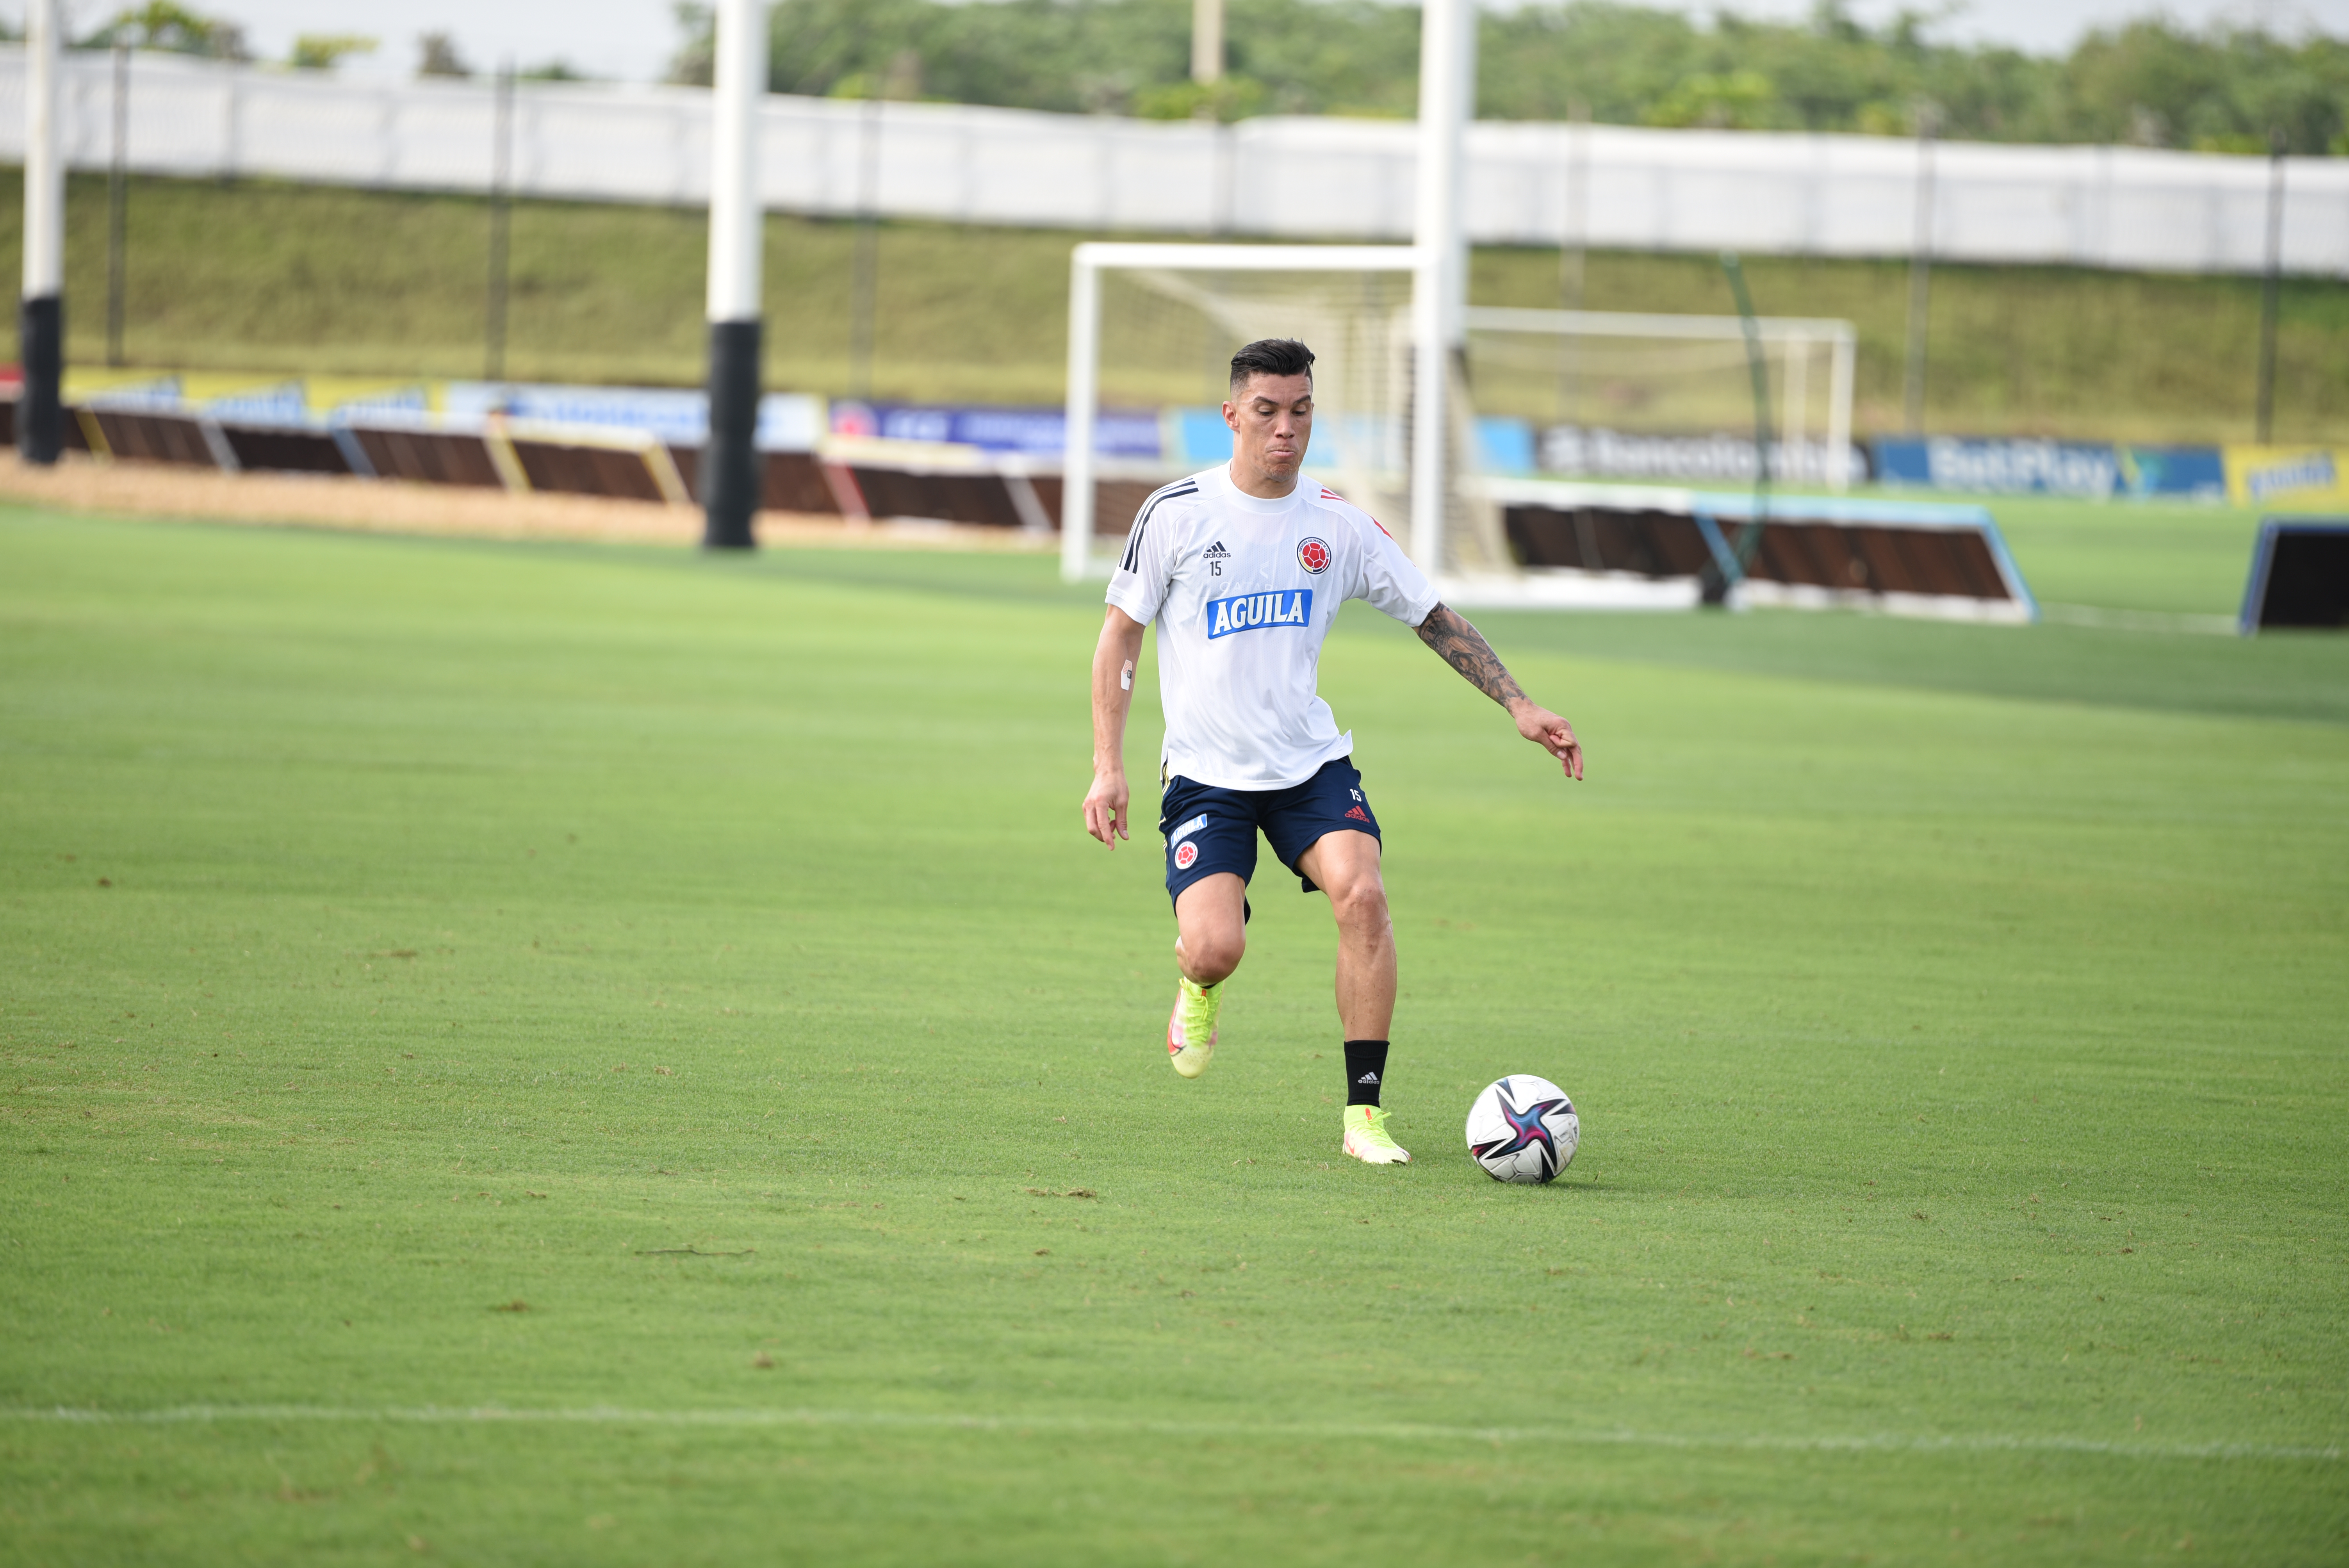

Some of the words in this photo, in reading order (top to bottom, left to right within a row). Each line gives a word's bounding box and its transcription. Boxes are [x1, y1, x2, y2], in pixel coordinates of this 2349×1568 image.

[1210, 561, 1221, 576] 15
[1212, 592, 1305, 636] AGUILA
[1349, 788, 1362, 802] 15
[1344, 813, 1370, 823] adidas
[1173, 816, 1204, 846] AGUILA
